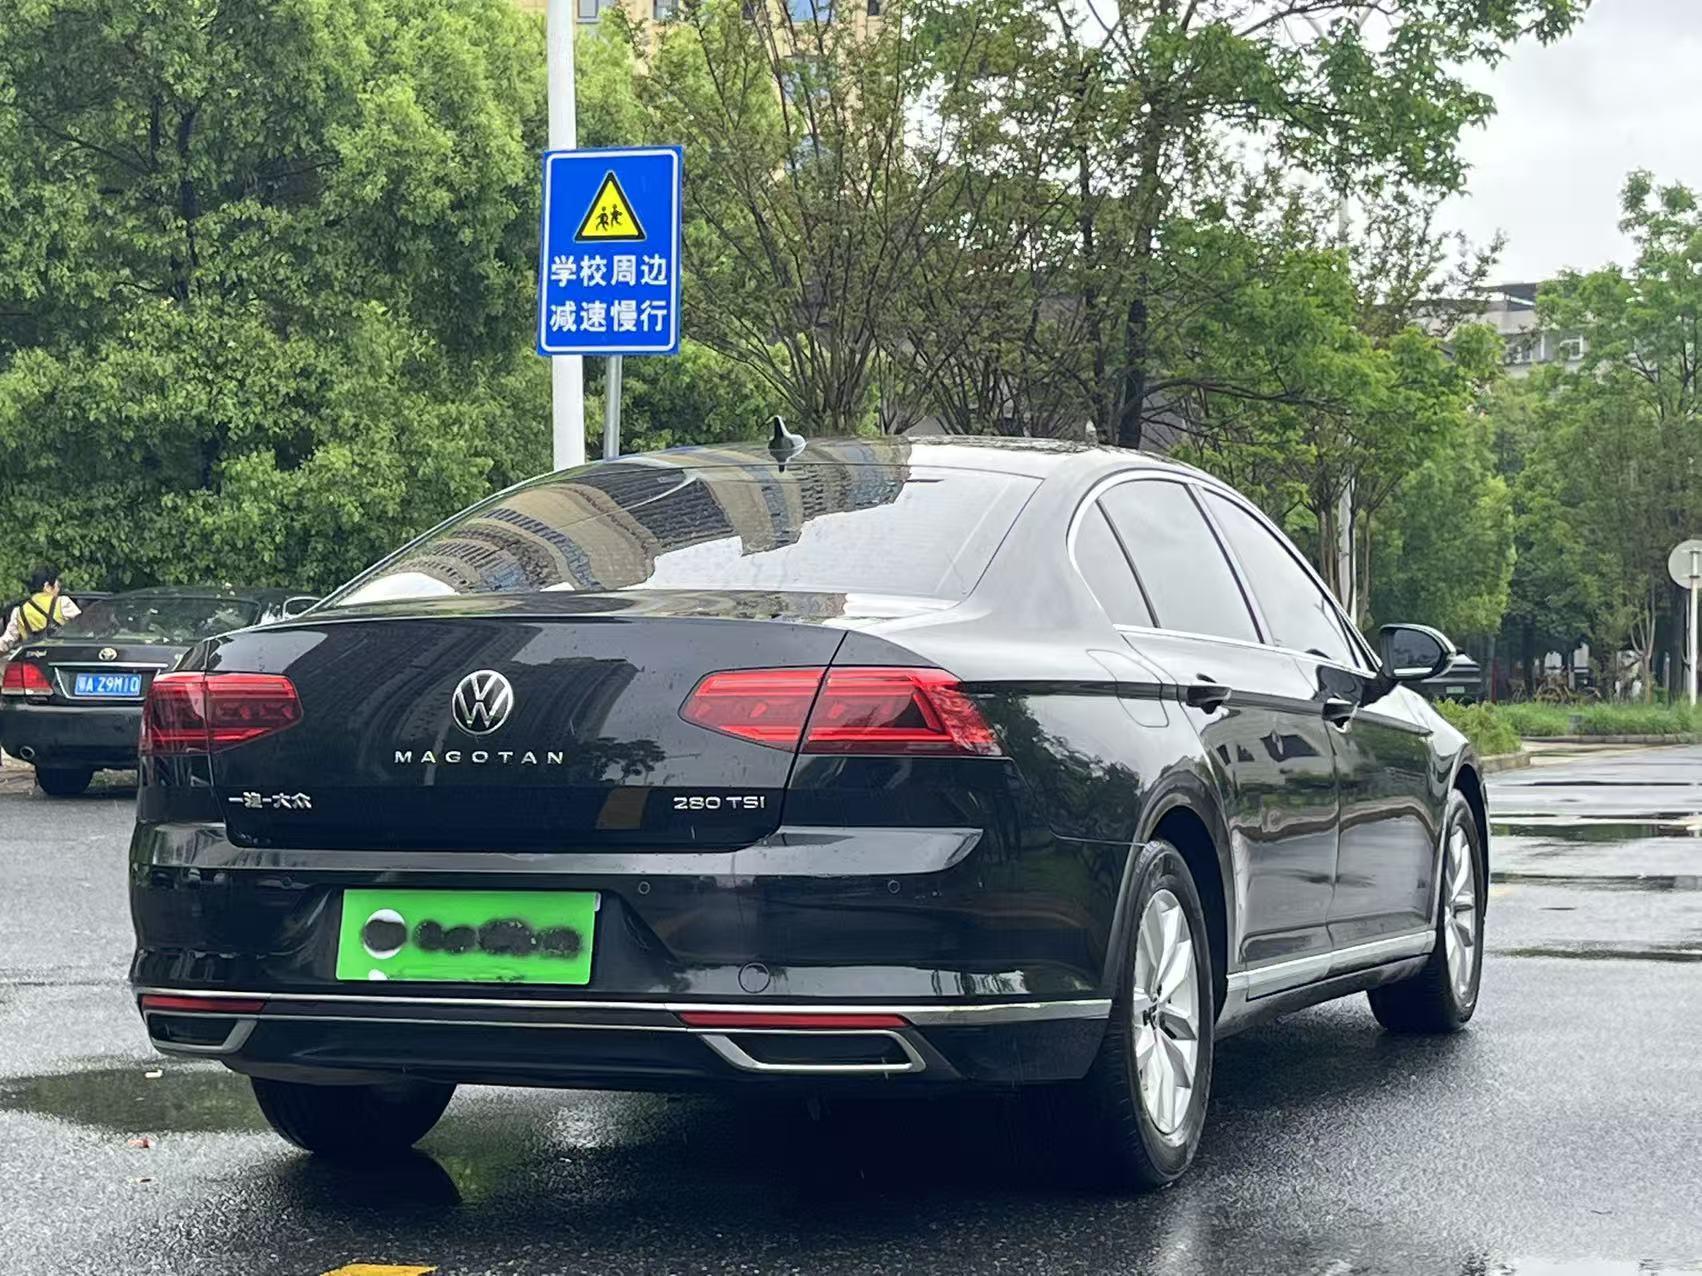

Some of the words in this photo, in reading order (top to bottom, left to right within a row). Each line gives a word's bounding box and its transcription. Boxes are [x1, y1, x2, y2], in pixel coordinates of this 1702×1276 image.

[550, 254, 667, 287] 学校周边
[549, 299, 667, 332] 减速慢行
[394, 750, 564, 764] MAGOTAN
[673, 796, 721, 810] 280
[725, 795, 765, 809] TSI
